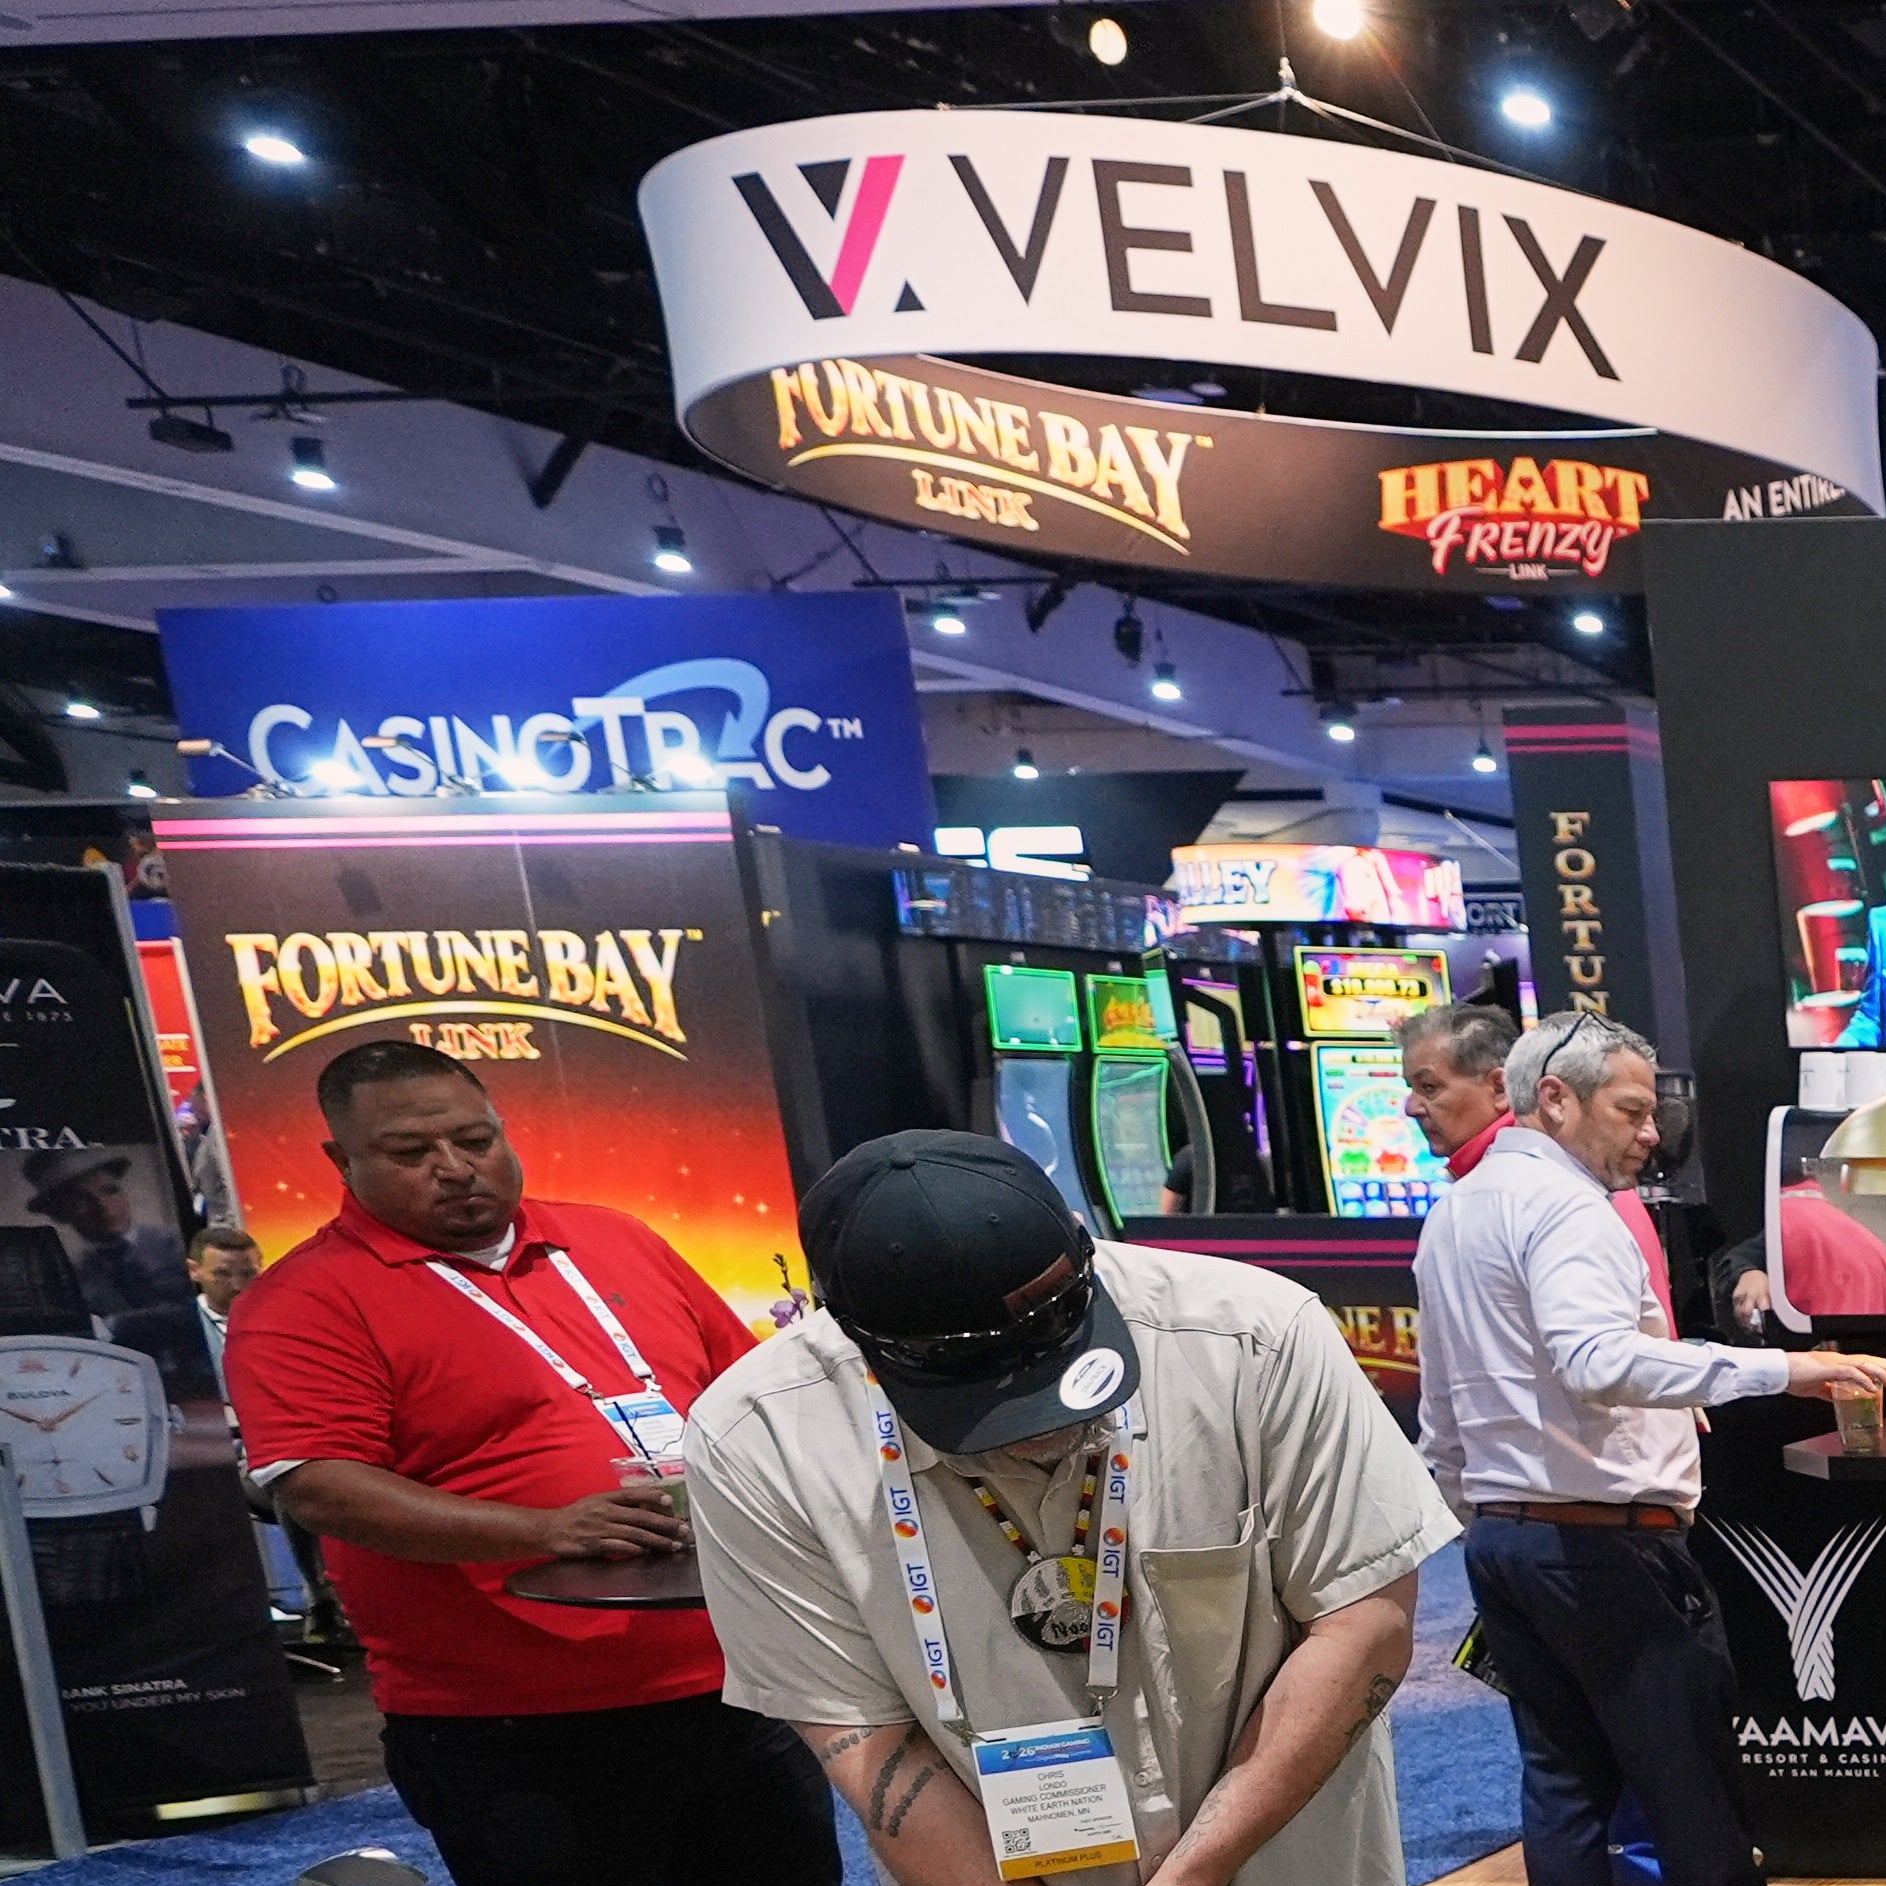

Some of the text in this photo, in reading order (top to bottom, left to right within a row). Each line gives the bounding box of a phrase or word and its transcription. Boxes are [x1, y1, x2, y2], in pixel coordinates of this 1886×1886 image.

[949, 153, 1622, 382] VELVIX
[769, 357, 1040, 472] FORTUNE
[911, 469, 1040, 531] LINK
[1378, 456, 1651, 528] HEART
[1722, 488, 1763, 521] AN
[1508, 562, 1549, 582] LINK
[225, 929, 540, 1049] FORTUNE
[408, 1021, 541, 1061] LINK
[876, 1410, 894, 1440] IGT
[889, 1486, 912, 1516] IGT
[1109, 1475, 1126, 1505] IGT
[906, 1563, 929, 1593] IGT
[1103, 1549, 1120, 1579] IGT
[1096, 1621, 1114, 1652] IGT
[924, 1638, 943, 1668] IGT
[111, 1679, 188, 1695] SINATRA
[1741, 1753, 1808, 1764] RESORT
[1819, 1753, 1829, 1764] &
[1769, 1768, 1880, 1778] AT SAN MANUEL
[1037, 1770, 1065, 1781] CHRIS
[1038, 1780, 1068, 1792] LONDO
[1001, 1783, 1107, 1807] GAMING COMMISSIONER
[1010, 1794, 1104, 1816] WHITE EARTH NATION
[1077, 1807, 1091, 1815] MN
[1034, 1850, 1103, 1868] PLATINUM PLUS
